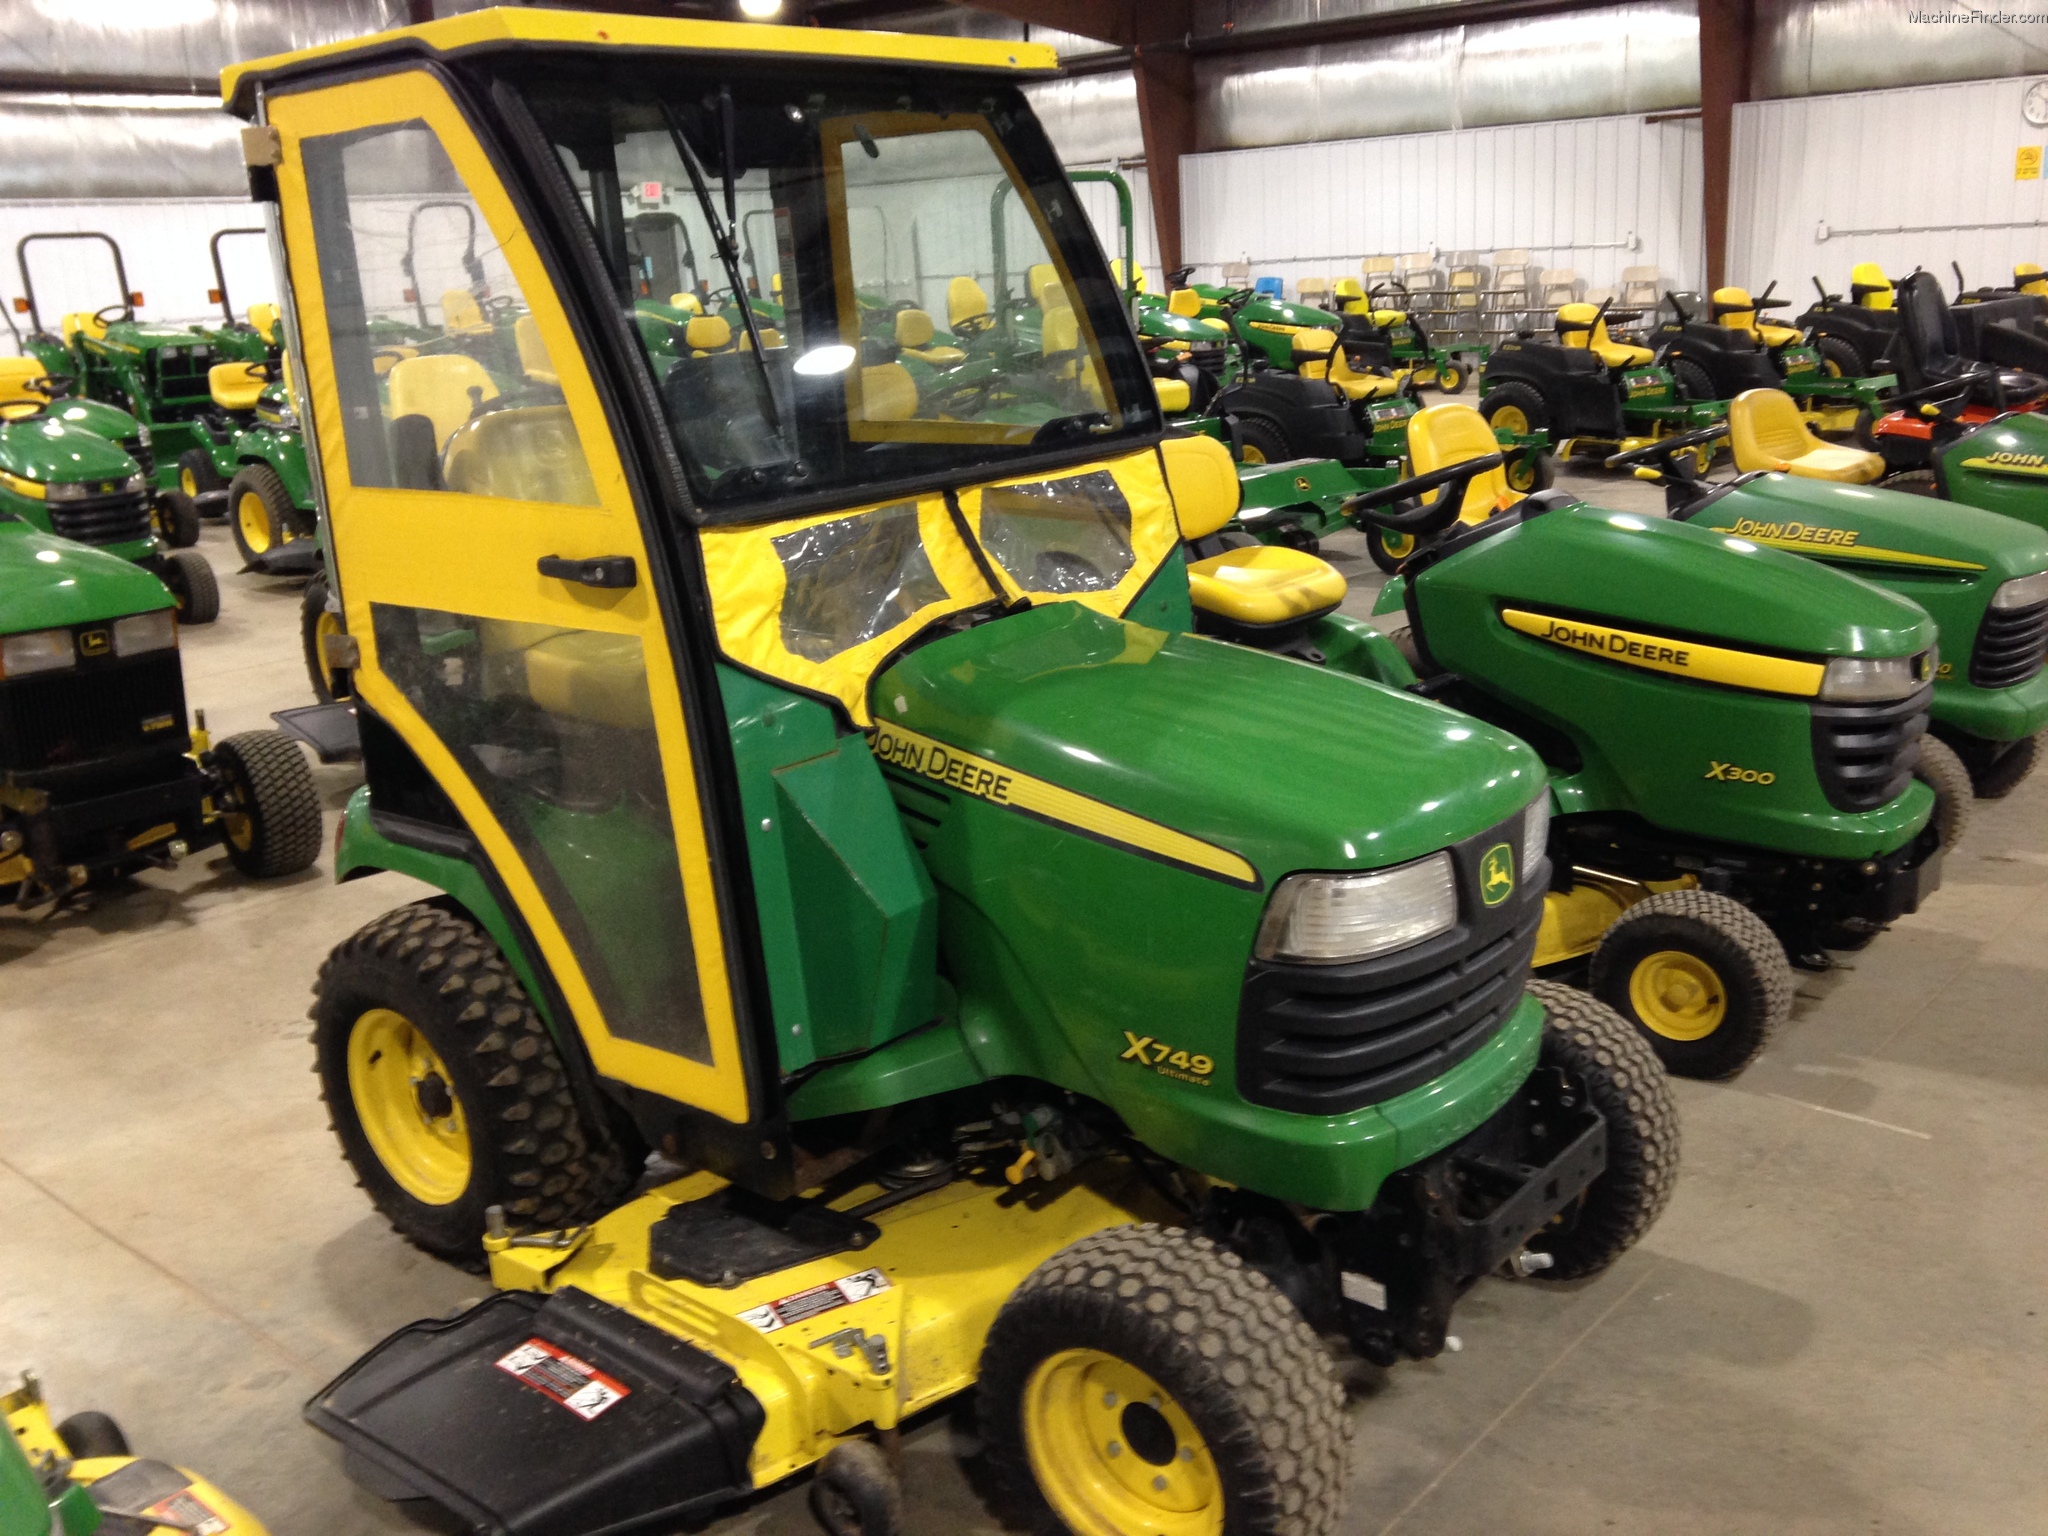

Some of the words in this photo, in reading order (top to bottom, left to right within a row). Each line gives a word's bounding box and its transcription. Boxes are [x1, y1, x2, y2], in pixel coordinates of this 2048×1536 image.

[1985, 451, 2045, 467] JOHN
[1726, 517, 1785, 539] JOHN
[1781, 521, 1859, 546] DEERE
[1541, 621, 1605, 650] JOHN
[1609, 634, 1690, 667] DEERE
[869, 729, 925, 769] JOHN
[928, 746, 1012, 801] DEERE
[1704, 760, 1777, 785] X300
[1120, 1030, 1214, 1075] X749
[1156, 1065, 1213, 1087] Ultimate
